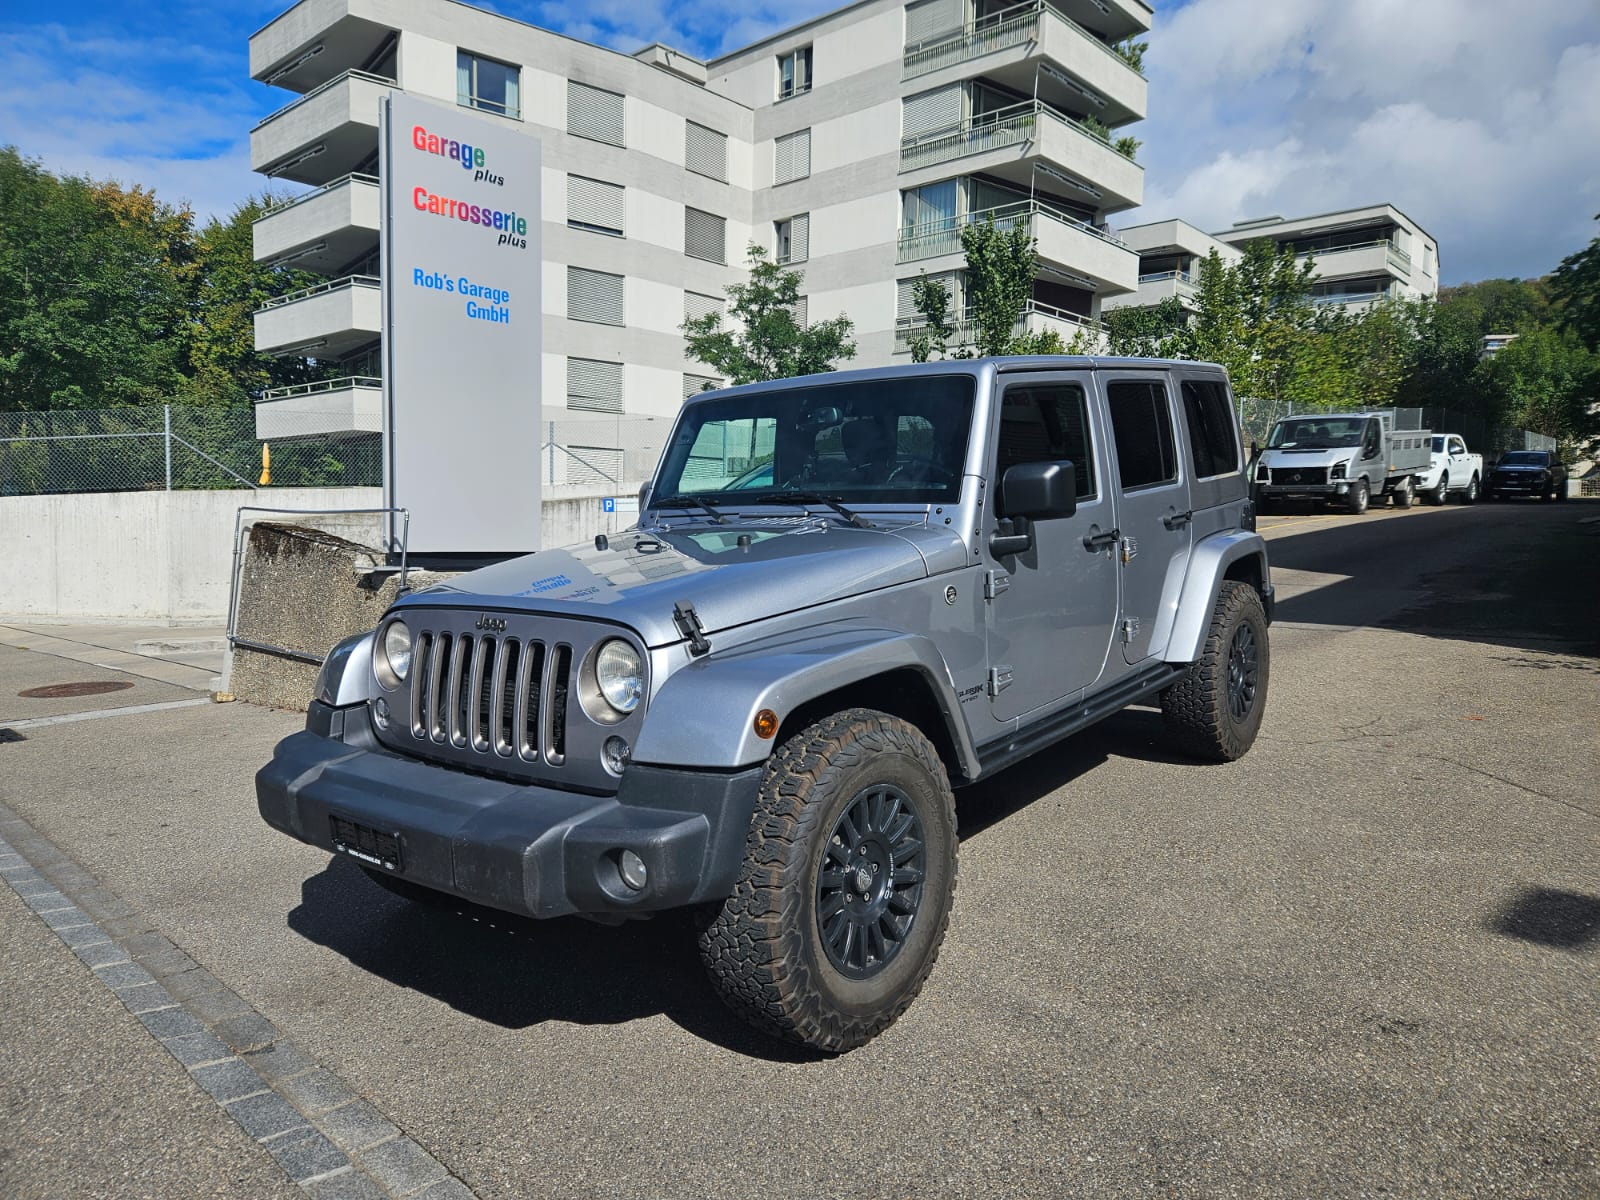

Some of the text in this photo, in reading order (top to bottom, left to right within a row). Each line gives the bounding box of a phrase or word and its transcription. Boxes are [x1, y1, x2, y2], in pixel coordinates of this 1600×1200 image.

[413, 125, 485, 170] Garage
[474, 169, 505, 186] plus
[413, 187, 527, 236] Carrosserie
[497, 233, 527, 249] plus
[413, 267, 510, 305] Rob's Garage
[466, 301, 509, 323] GmbH
[475, 612, 507, 634] Jeep
